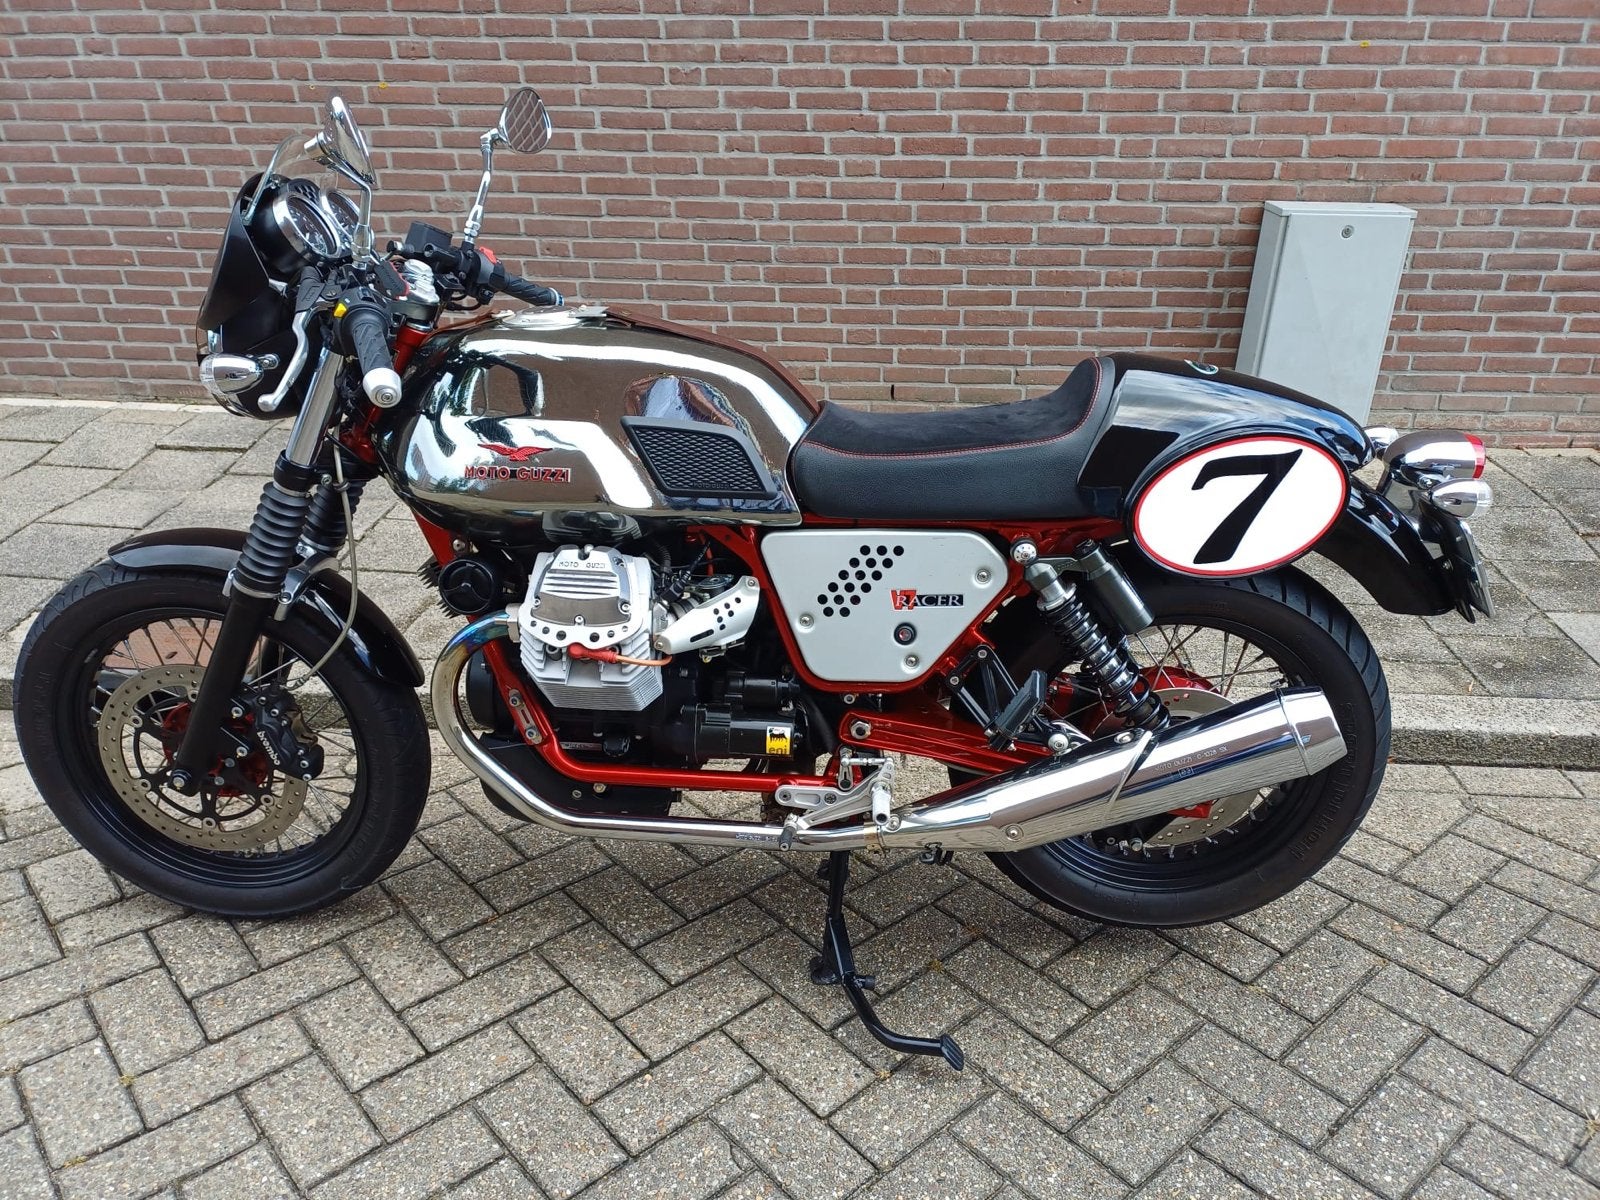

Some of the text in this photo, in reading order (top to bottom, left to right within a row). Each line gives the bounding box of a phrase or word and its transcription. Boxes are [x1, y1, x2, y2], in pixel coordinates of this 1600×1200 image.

[464, 465, 571, 483] MOTO GUZZI
[1192, 448, 1303, 564] 7
[895, 594, 961, 607] RACER
[257, 731, 280, 765] brembo
[769, 745, 787, 754] eni
